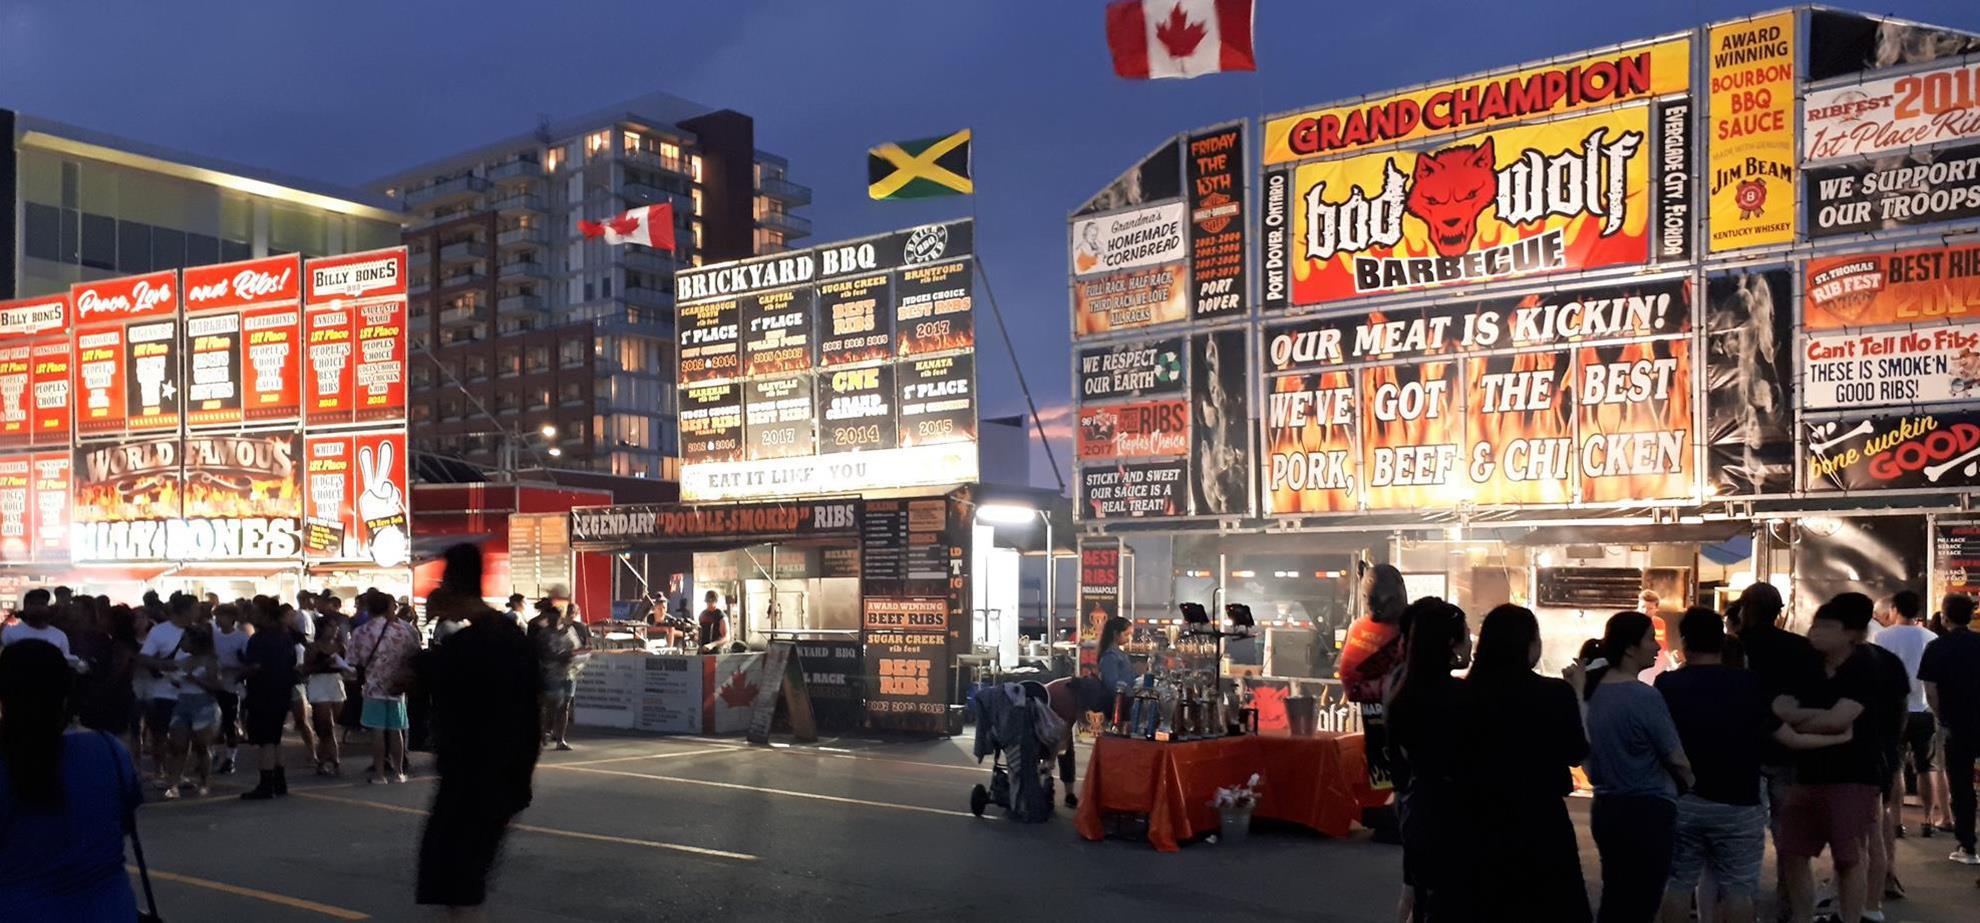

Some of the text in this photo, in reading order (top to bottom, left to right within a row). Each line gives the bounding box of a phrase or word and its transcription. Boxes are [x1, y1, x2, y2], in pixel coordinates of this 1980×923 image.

[1721, 27, 1781, 50] AWARD
[1715, 42, 1788, 68] WINNING
[1711, 65, 1791, 94] BOURBON
[1289, 53, 1652, 156] GRAND CHAMPION
[1731, 89, 1772, 114] BBQ
[1895, 67, 1980, 120] 201
[1808, 95, 1894, 121] RIBFEST
[1719, 110, 1785, 140] SAUCE
[1191, 133, 1237, 156] FRIDAY
[1664, 106, 1688, 171] EVERGLADE
[1809, 119, 1931, 161] 1st Place
[1198, 154, 1226, 175] THE
[1712, 157, 1792, 195] JIM BEAM
[1197, 174, 1232, 195] 13TH
[1820, 159, 1980, 200] WE SUPPORT
[1265, 175, 1284, 226] ONTARIO
[1306, 127, 1643, 261] bad wolf
[1818, 186, 1980, 228] OUR TROOPS
[1112, 210, 1162, 233] Grandma's
[1664, 204, 1687, 255] FLORIDA
[1713, 223, 1790, 240] KENTUCKY WHISKEY
[1108, 221, 1178, 252] HOMEMADE
[1106, 235, 1180, 266] CORNBREAD
[1355, 230, 1564, 293] BARBECUE
[316, 261, 396, 287] BILLY BONES
[678, 256, 813, 300] BRICKYARD
[822, 243, 876, 275] BBQ
[905, 264, 964, 280] BRANTFORD
[1815, 261, 1874, 284] ST. THOMAS
[1889, 252, 1944, 283] BEST
[190, 268, 291, 301] and Ribs!
[822, 276, 887, 294] SUGAR CREEK
[1129, 275, 1149, 290] HALF
[1201, 278, 1233, 296] PORT
[1266, 269, 1284, 300] PORT
[1812, 273, 1882, 303] RIB FEST
[78, 281, 171, 318] Peace, Love
[759, 292, 794, 305] CAPITAL
[932, 289, 965, 301] CHOICE
[1198, 294, 1239, 313] DOVER
[1, 306, 62, 326] BILLY BONES
[762, 313, 802, 329] PLACE
[832, 300, 876, 319] BEST
[693, 325, 737, 343] PLACE
[917, 320, 950, 337] 2017
[1270, 293, 1670, 365] OUR MEAT IS KICKIN!
[1807, 330, 1979, 361] Can't Tell No Fibs
[1083, 349, 1157, 374] WE RESPECT
[1810, 354, 1948, 383] THESE IS SMOKE'N
[832, 368, 879, 392] CNE
[917, 380, 968, 398] PLACE
[1085, 371, 1155, 394] OUR EARTH
[1836, 380, 1919, 403] GOOD RIBS!
[1269, 358, 1677, 429] WE'VE GOT THE BEST
[919, 419, 952, 436] 2015
[1141, 404, 1184, 434] RIBS
[762, 428, 795, 445] 2017
[835, 425, 879, 445] 2014
[1085, 445, 1112, 455] 2017
[1809, 415, 1938, 479] bone suckin
[1868, 423, 1980, 480] GOOD
[86, 443, 174, 483] WORLD
[185, 438, 292, 477] FAMOUS
[1271, 450, 1355, 496] PORK,
[1371, 444, 1457, 487] BEEF
[1470, 442, 1496, 481] &
[709, 473, 741, 488] EAT
[746, 471, 764, 485] IT
[1086, 469, 1181, 486] STICKY AND SWEET
[1091, 484, 1172, 499] OUR SAUCE IS A
[1102, 498, 1164, 513] REAL TREAT!
[572, 512, 657, 535] LEGENDARY
[814, 504, 854, 528] RIBS
[1083, 550, 1117, 566] BEST
[1083, 568, 1116, 584] RIBS
[867, 601, 943, 611] AWARD WINNING
[868, 613, 904, 625] BEEF
[908, 613, 944, 625] RIBS
[867, 634, 944, 645] SUGAR CREEK
[889, 645, 902, 653] rib
[879, 659, 930, 676] BEST
[813, 674, 845, 685] RACK
[880, 677, 929, 695] RIBS
[1318, 704, 1348, 732] olf
